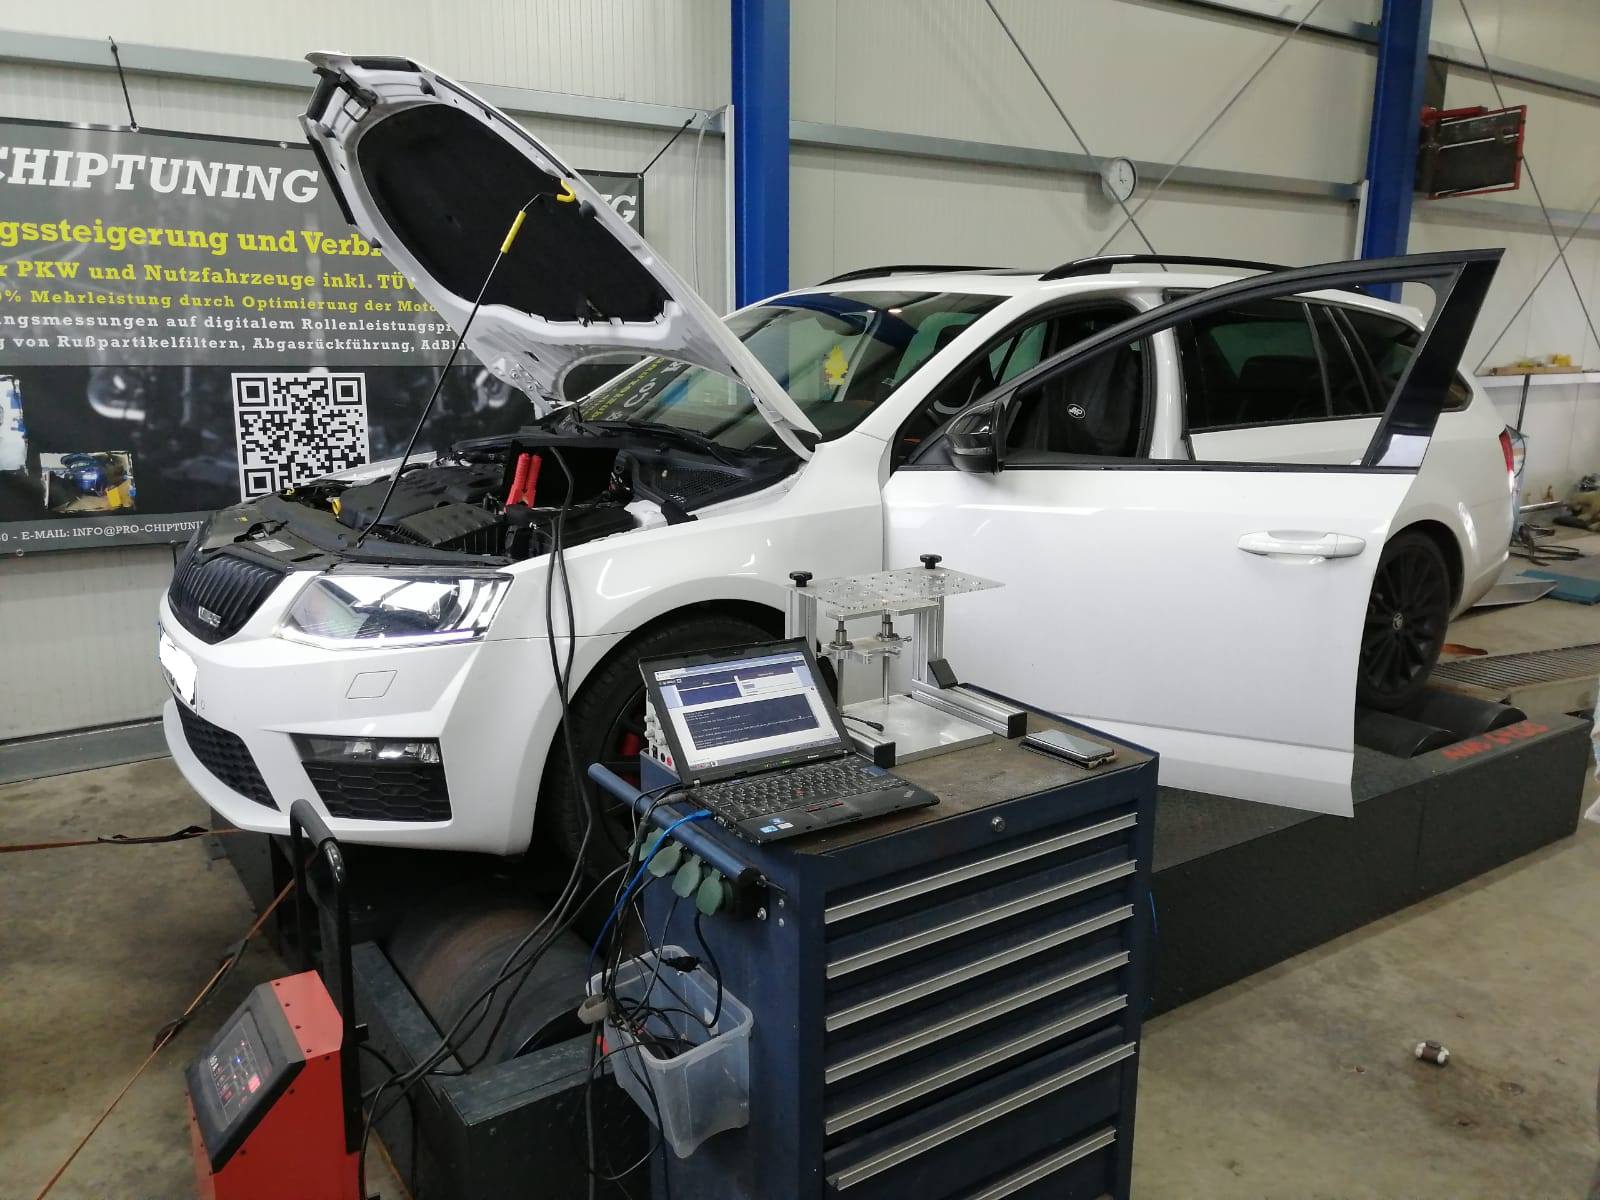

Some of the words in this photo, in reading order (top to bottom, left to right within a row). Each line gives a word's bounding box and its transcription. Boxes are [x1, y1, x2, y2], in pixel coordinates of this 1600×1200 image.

[0, 147, 319, 203] HIPTUNING
[0, 218, 229, 256] gssteigerung
[237, 230, 298, 253] und
[16, 260, 80, 279] PKW
[88, 264, 136, 280] und
[144, 264, 316, 291] Nutzfahrzeuge
[322, 272, 373, 289] inkl.
[30, 289, 172, 309] Mehrleistung
[179, 293, 235, 307] durch
[241, 295, 358, 313] Optimierung
[364, 299, 392, 312] der
[0, 314, 159, 329] ngsmessungen
[166, 315, 197, 328] auf
[204, 315, 296, 332] digitalem
[12, 337, 50, 348] von
[56, 335, 246, 351] Rußpartikelfiltern,
[252, 337, 415, 353] Abgasrückführung,
[21, 529, 70, 541] E-MAIL:
